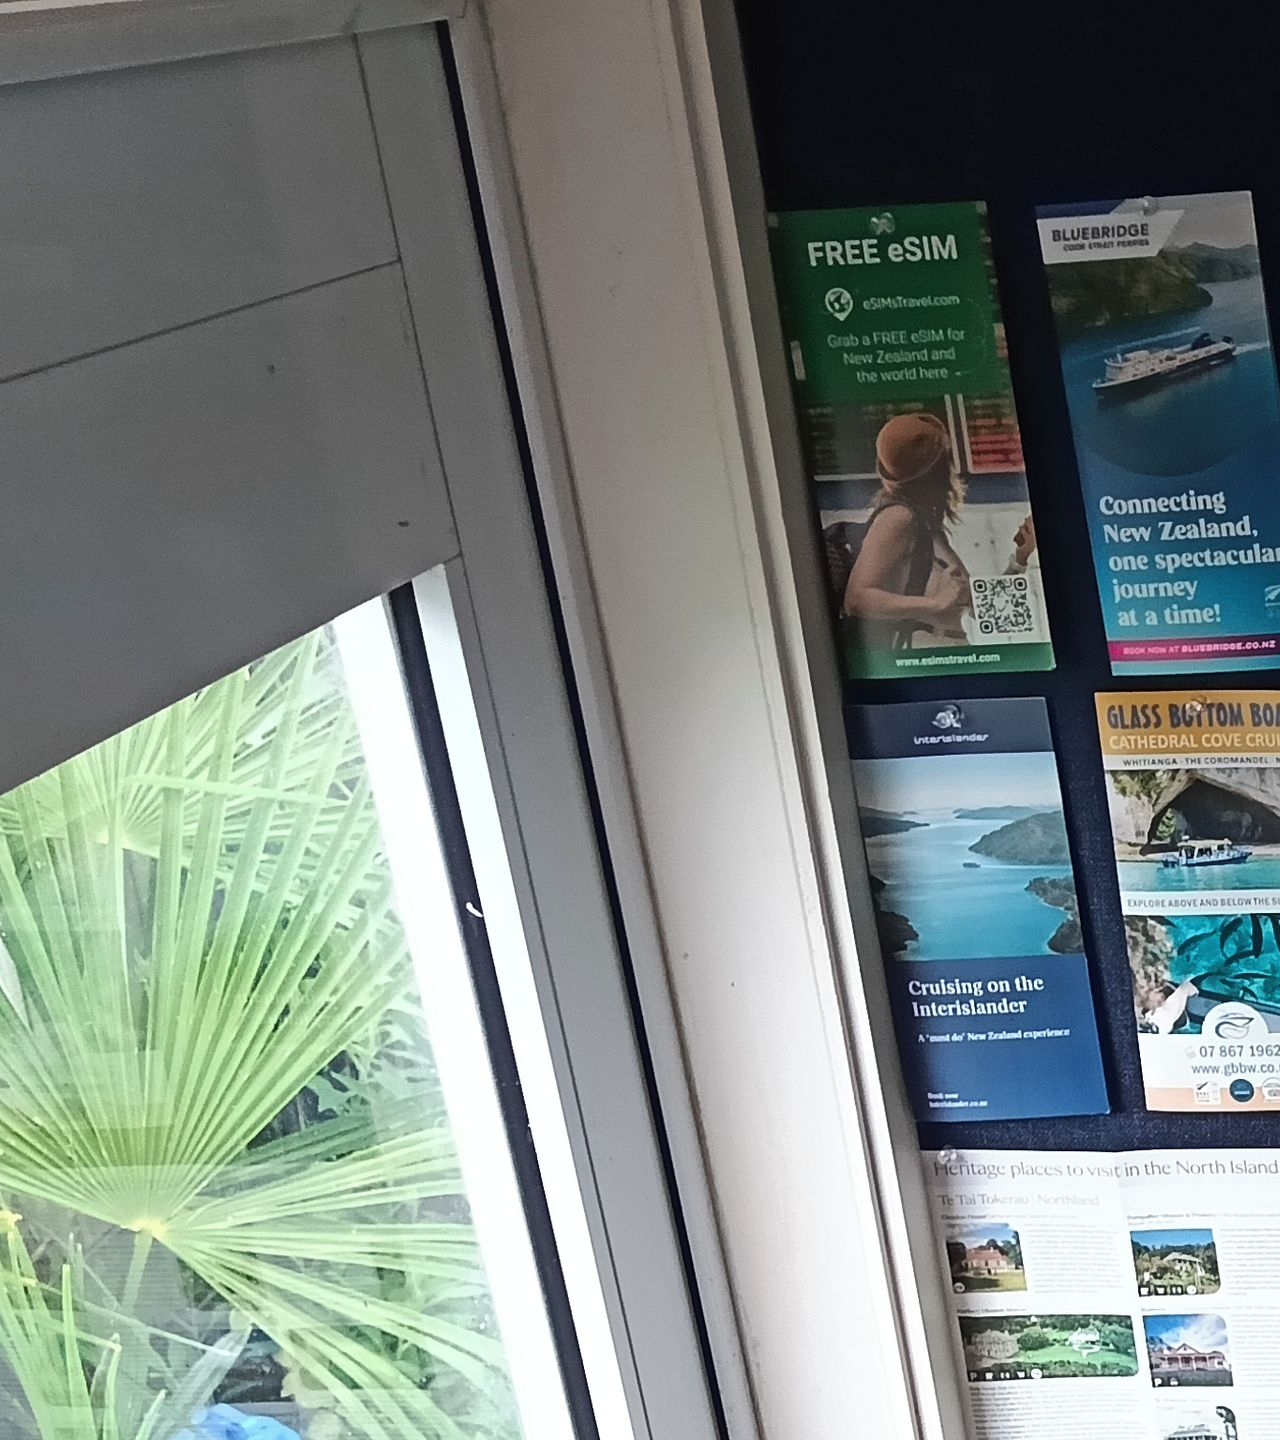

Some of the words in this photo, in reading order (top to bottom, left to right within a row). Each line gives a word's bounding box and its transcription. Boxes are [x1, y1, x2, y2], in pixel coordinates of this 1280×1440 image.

[1051, 223, 1150, 243] BLUEBRIDGE
[808, 238, 880, 266] FREE
[888, 235, 958, 262] eSIM
[843, 351, 866, 365] New
[870, 349, 918, 363] Zealand
[922, 347, 955, 360] and
[857, 369, 873, 382] the
[877, 368, 913, 381] world
[916, 366, 948, 379] here
[1100, 491, 1226, 515] Connecting
[1103, 526, 1151, 544] New
[1159, 518, 1258, 541] Zealand,
[1108, 733, 1198, 749] CATHEDRAL
[1201, 733, 1242, 748] COVE
[908, 978, 984, 998] Cruising
[988, 980, 1011, 994] on
[1015, 975, 1044, 992] the
[912, 998, 1028, 1018] Interislander
[1199, 1044, 1215, 1058] 07
[1219, 1044, 1245, 1058] 867
[933, 1160, 1006, 1180] Heritage
[1010, 1159, 1062, 1179] places
[1066, 1162, 1083, 1176] to
[1088, 1161, 1120, 1177] visit
[1124, 1160, 1136, 1175] in
[1140, 1160, 1170, 1175] the
[1175, 1159, 1225, 1175] North
[1229, 1158, 1279, 1174] Island
